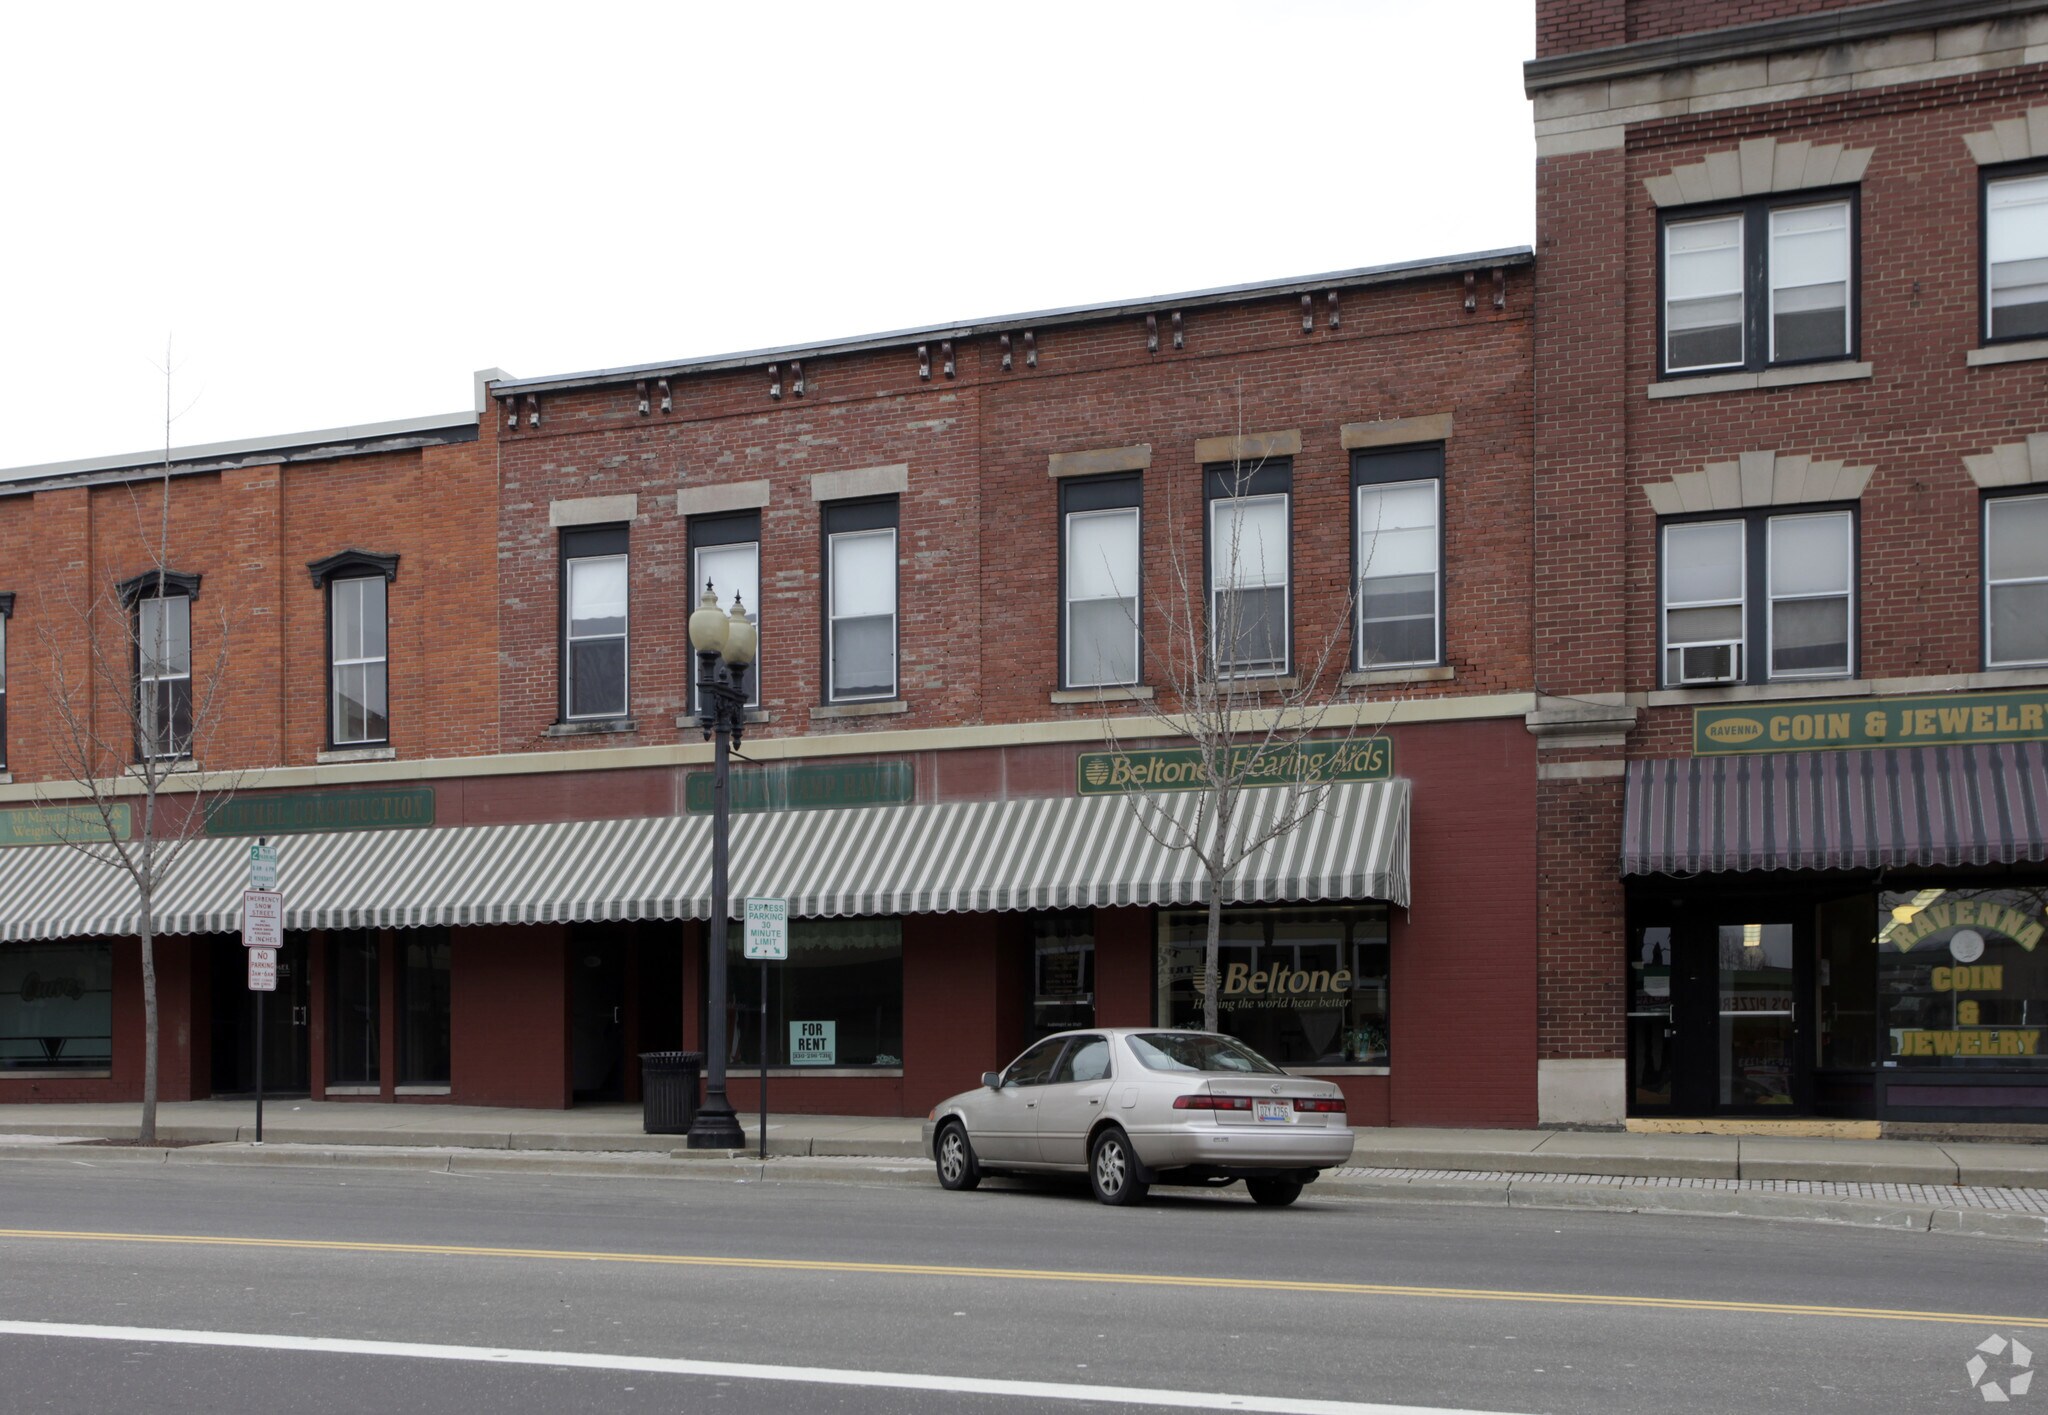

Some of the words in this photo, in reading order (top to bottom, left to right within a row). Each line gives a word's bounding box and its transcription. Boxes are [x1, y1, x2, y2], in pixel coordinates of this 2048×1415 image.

[1710, 722, 1759, 736] RAVENNA
[1769, 712, 1850, 742] COIN
[1864, 711, 1887, 738] &
[1900, 703, 2048, 737] JEWELR
[1109, 756, 1211, 785] Beltone
[1230, 748, 1326, 781] Hearing
[1328, 742, 1384, 773] Aids
[295, 795, 424, 824] CONSTRUCTION
[12, 812, 24, 824] 30
[12, 826, 52, 841] Weight
[252, 848, 259, 859] 2
[246, 895, 279, 903] EMERGENCY
[748, 903, 784, 912] EXPRESS
[749, 912, 783, 921] PARKING
[761, 921, 771, 929] 30
[1889, 901, 2045, 953] RAVENNA
[750, 929, 782, 938] MINUTE
[755, 938, 777, 946] LIMIT
[257, 951, 268, 960] NO
[1224, 962, 1352, 994] Beltone
[1931, 965, 2003, 992] COIN
[1193, 998, 1235, 1012] Hing
[1238, 998, 1254, 1009] the
[1257, 997, 1288, 1009] world
[1290, 997, 1315, 1008] hear
[1319, 997, 1351, 1008] better
[1957, 1000, 1980, 1025] &
[802, 1023, 823, 1036] FOR
[798, 1038, 827, 1051] RENT
[1901, 1030, 2040, 1056] JEWELRY
